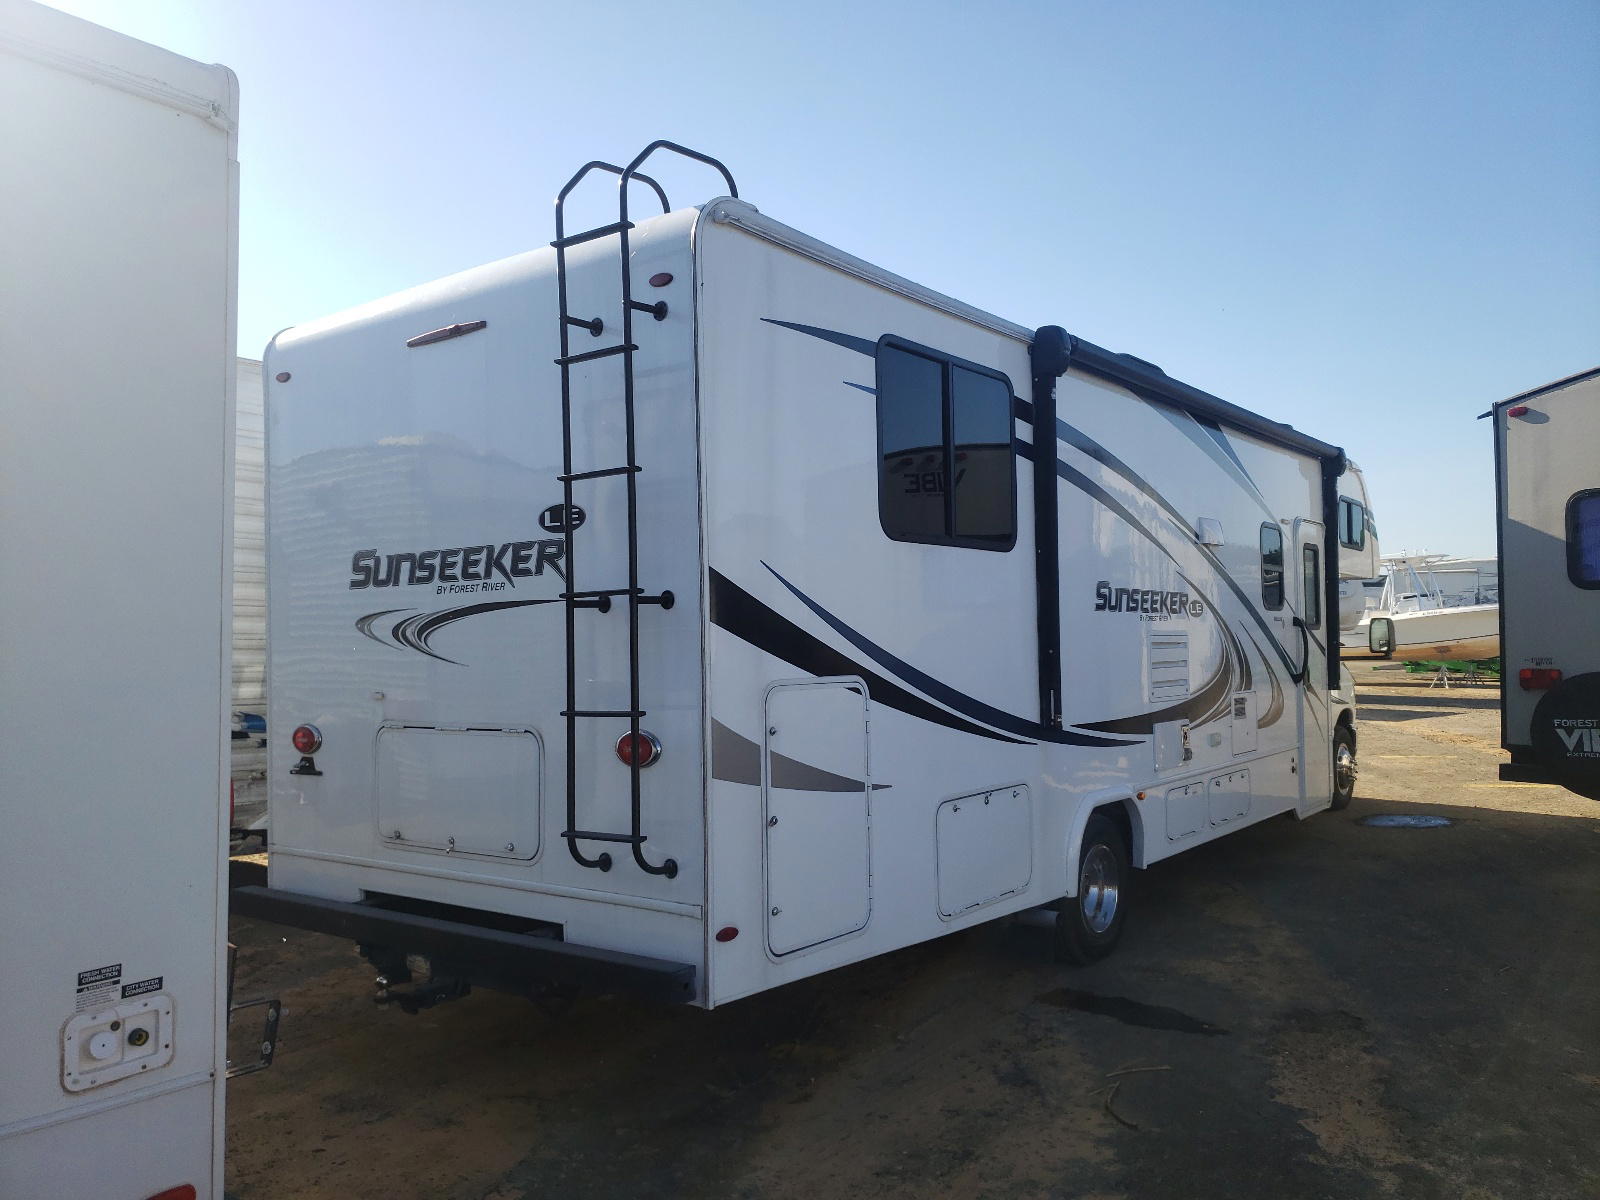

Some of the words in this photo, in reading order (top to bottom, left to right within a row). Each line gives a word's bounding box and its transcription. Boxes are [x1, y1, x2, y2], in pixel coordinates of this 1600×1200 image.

[436, 585, 447, 595] BY
[449, 583, 480, 594] FOREST
[481, 582, 506, 592] RIVER
[1190, 603, 1202, 614] LE
[1554, 719, 1599, 727] FOREST
[140, 979, 159, 987] WATER
